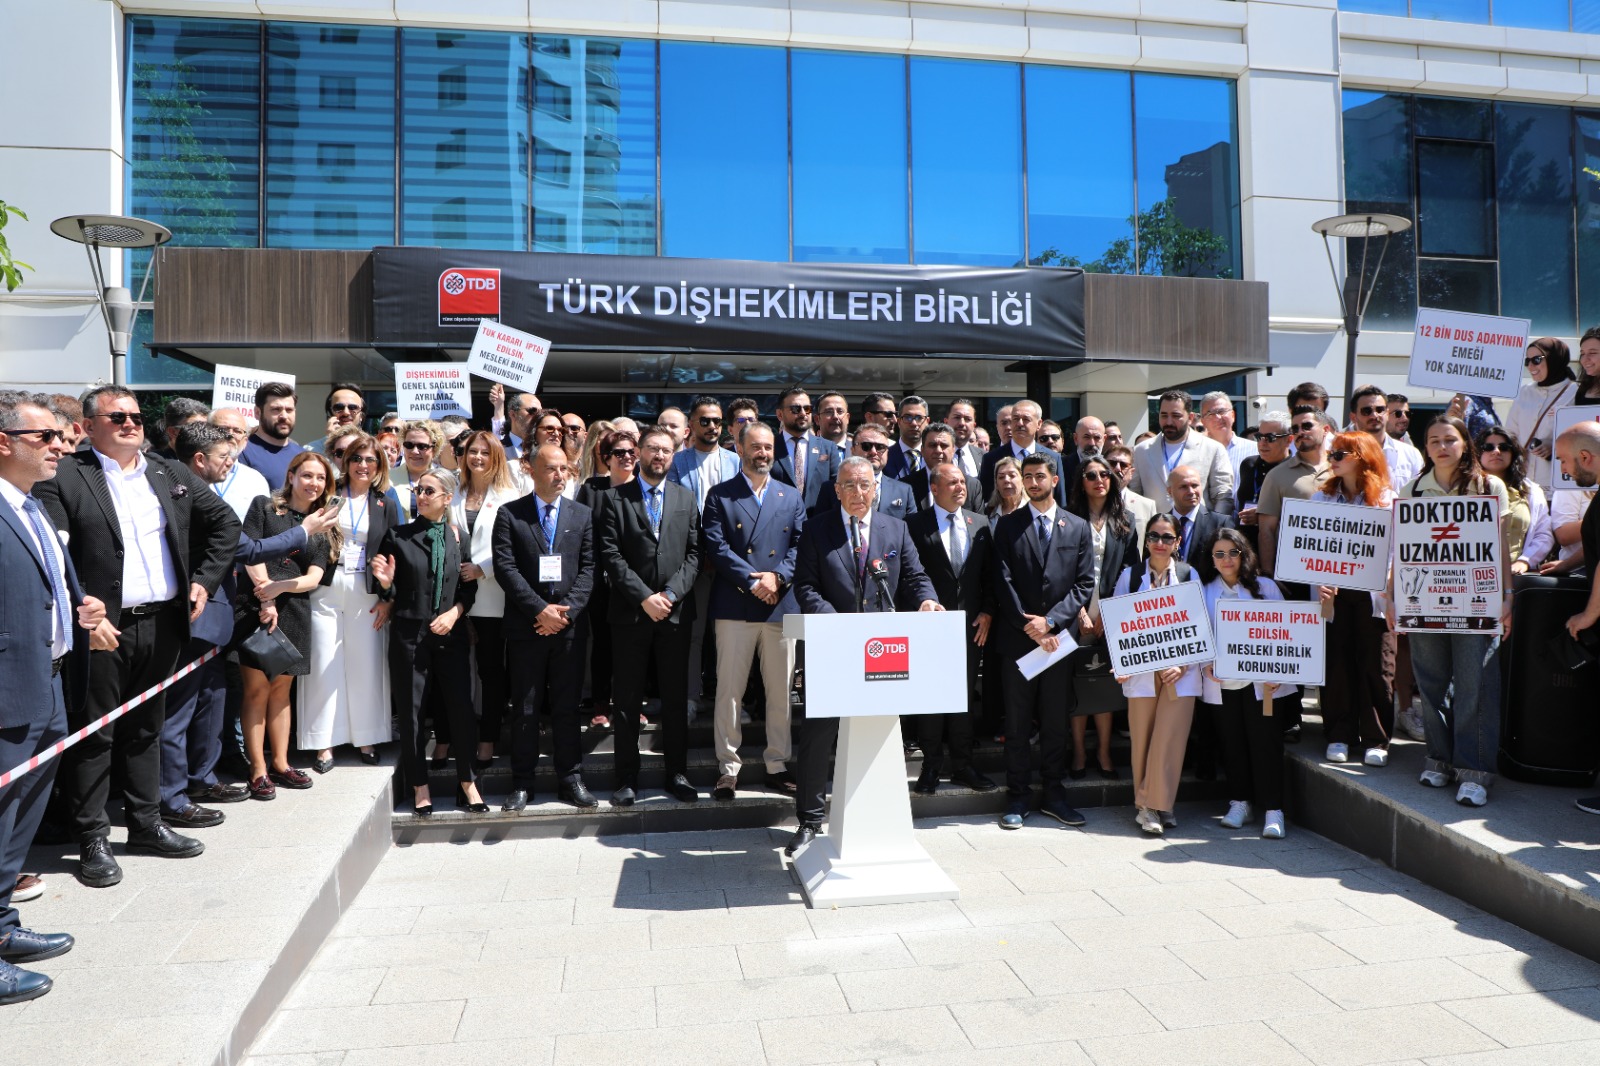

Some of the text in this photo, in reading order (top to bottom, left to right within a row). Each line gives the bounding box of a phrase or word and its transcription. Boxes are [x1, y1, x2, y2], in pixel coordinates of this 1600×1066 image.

[466, 278, 496, 290] TDB
[539, 278, 1032, 326] TÜRK DİŞHEKİMLERİ BİRLİĞİ
[497, 333, 522, 346] KARARI
[525, 342, 544, 355] İPTAL
[1419, 324, 1523, 348] 12 BİN DUS ADAYININ
[1452, 345, 1484, 361] EMEĞİ
[479, 350, 533, 374] MESLEKİ BİRLİK
[482, 363, 523, 383] KORUNSUN!
[1425, 360, 1505, 381] YOK SAYILAMAZ!
[220, 376, 263, 390] MESLEĞİ
[402, 382, 427, 390] GENEL
[225, 390, 256, 404] BİRLİĞ
[414, 393, 454, 401] AYRILMAZ
[1400, 501, 1493, 524] DOKTORA
[1288, 514, 1386, 538] MESLEĞİMİZİN
[1294, 534, 1375, 559] BİRLİĞİ İÇİN
[1400, 542, 1494, 562] UZMANLIK
[1433, 569, 1466, 577] UZMANLIK
[1433, 577, 1467, 585] SINAVIYLA
[1475, 568, 1495, 581] DUS
[1428, 585, 1468, 594] KAZANILIR!
[1134, 595, 1176, 614] UNVAN
[1121, 610, 1190, 634] DAĞITARAK
[1221, 610, 1319, 625] TUK KARARI İPTAL
[1118, 625, 1198, 651] MAĞDURİYET
[1248, 626, 1293, 641] EDİLSİN,
[884, 643, 907, 654] TDB
[1120, 640, 1208, 668] GİDERİLEMEZ!
[1227, 642, 1312, 658] MESLEKİ BİRLİK
[1238, 660, 1300, 675] KORUNSUN!
